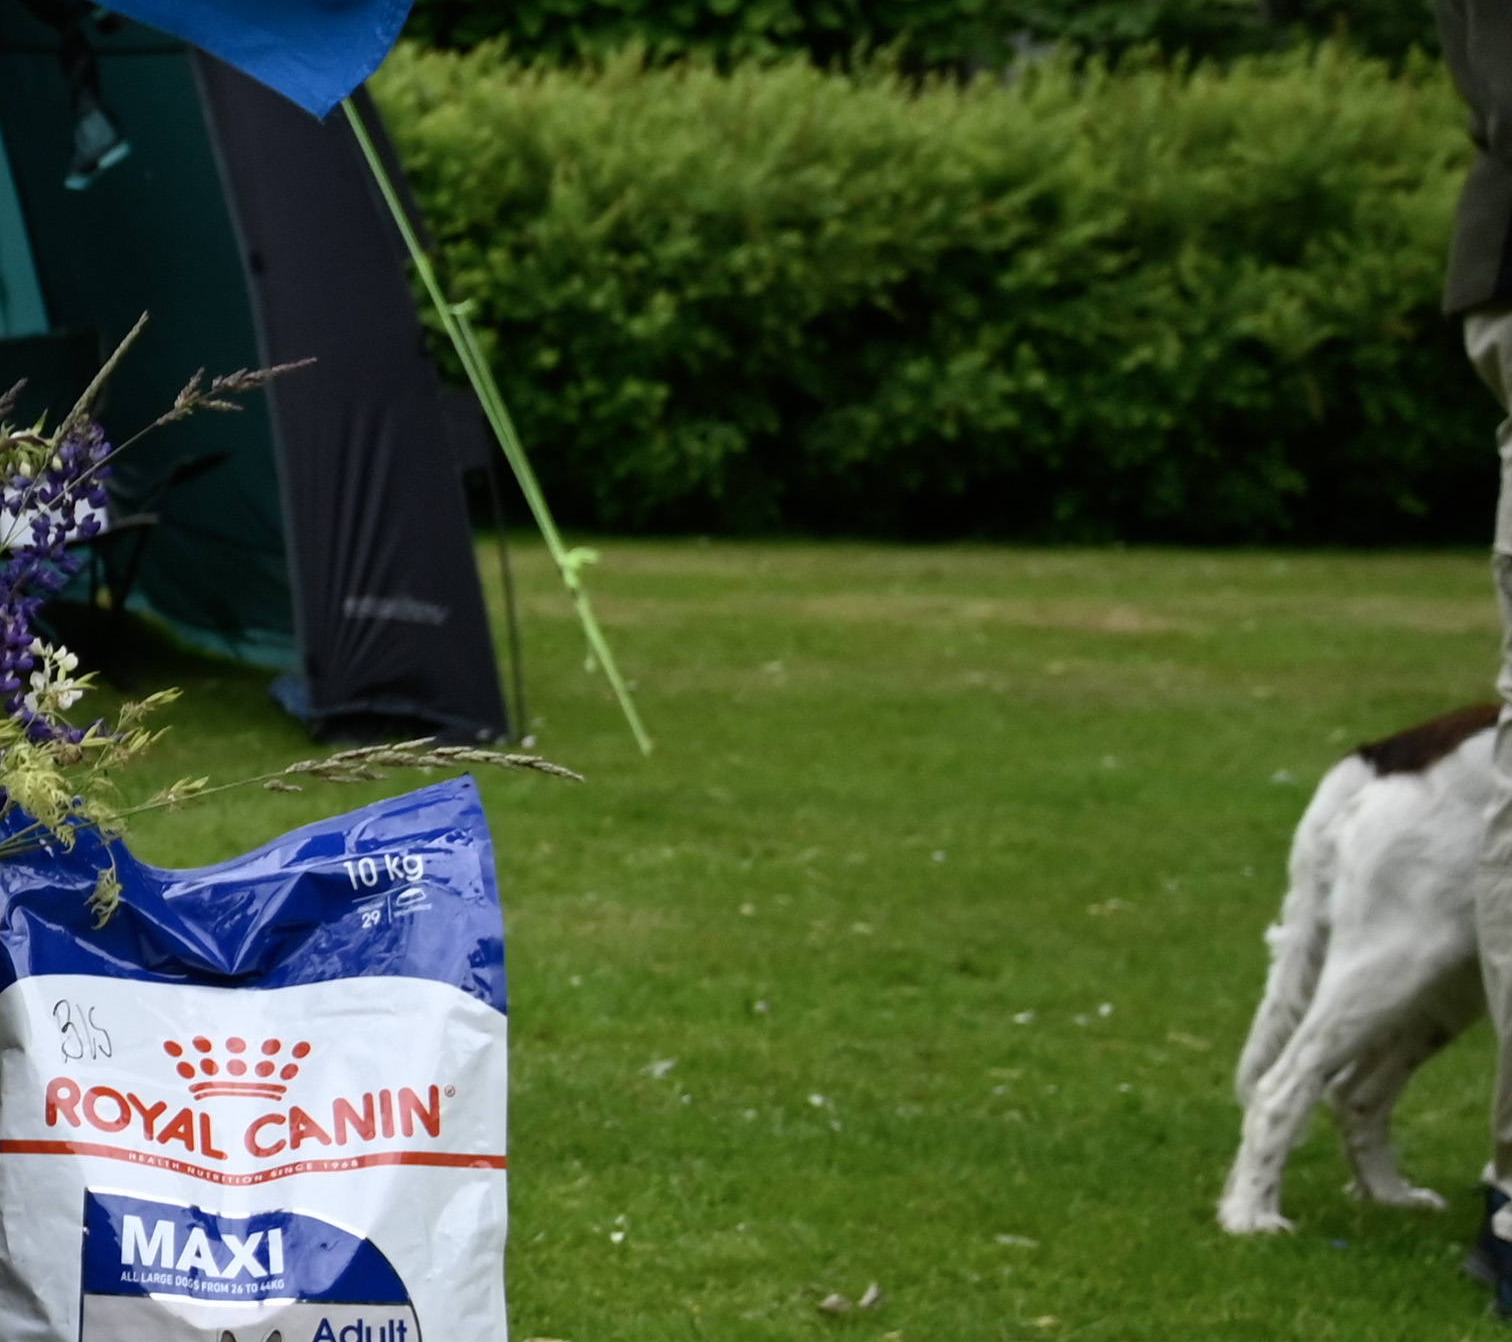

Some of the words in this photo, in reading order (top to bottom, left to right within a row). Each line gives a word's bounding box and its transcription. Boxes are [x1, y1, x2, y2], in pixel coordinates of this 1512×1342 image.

[343, 857, 378, 890] 10
[384, 853, 424, 881] kg
[361, 909, 381, 928] 29
[44, 1076, 229, 1161] ROYAL
[128, 1152, 180, 1170] HEALTH
[187, 1165, 263, 1185] NUTRITION
[270, 1161, 313, 1178] SINCE
[323, 1158, 359, 1169] 1968
[120, 1214, 285, 1279] MAXI
[120, 1270, 139, 1282] ALL
[141, 1272, 173, 1286] LARGE
[175, 1276, 199, 1291] DOGS
[201, 1281, 229, 1293] FROM
[231, 1283, 244, 1294] 26
[246, 1283, 258, 1293] TO
[260, 1279, 285, 1292] 44KG
